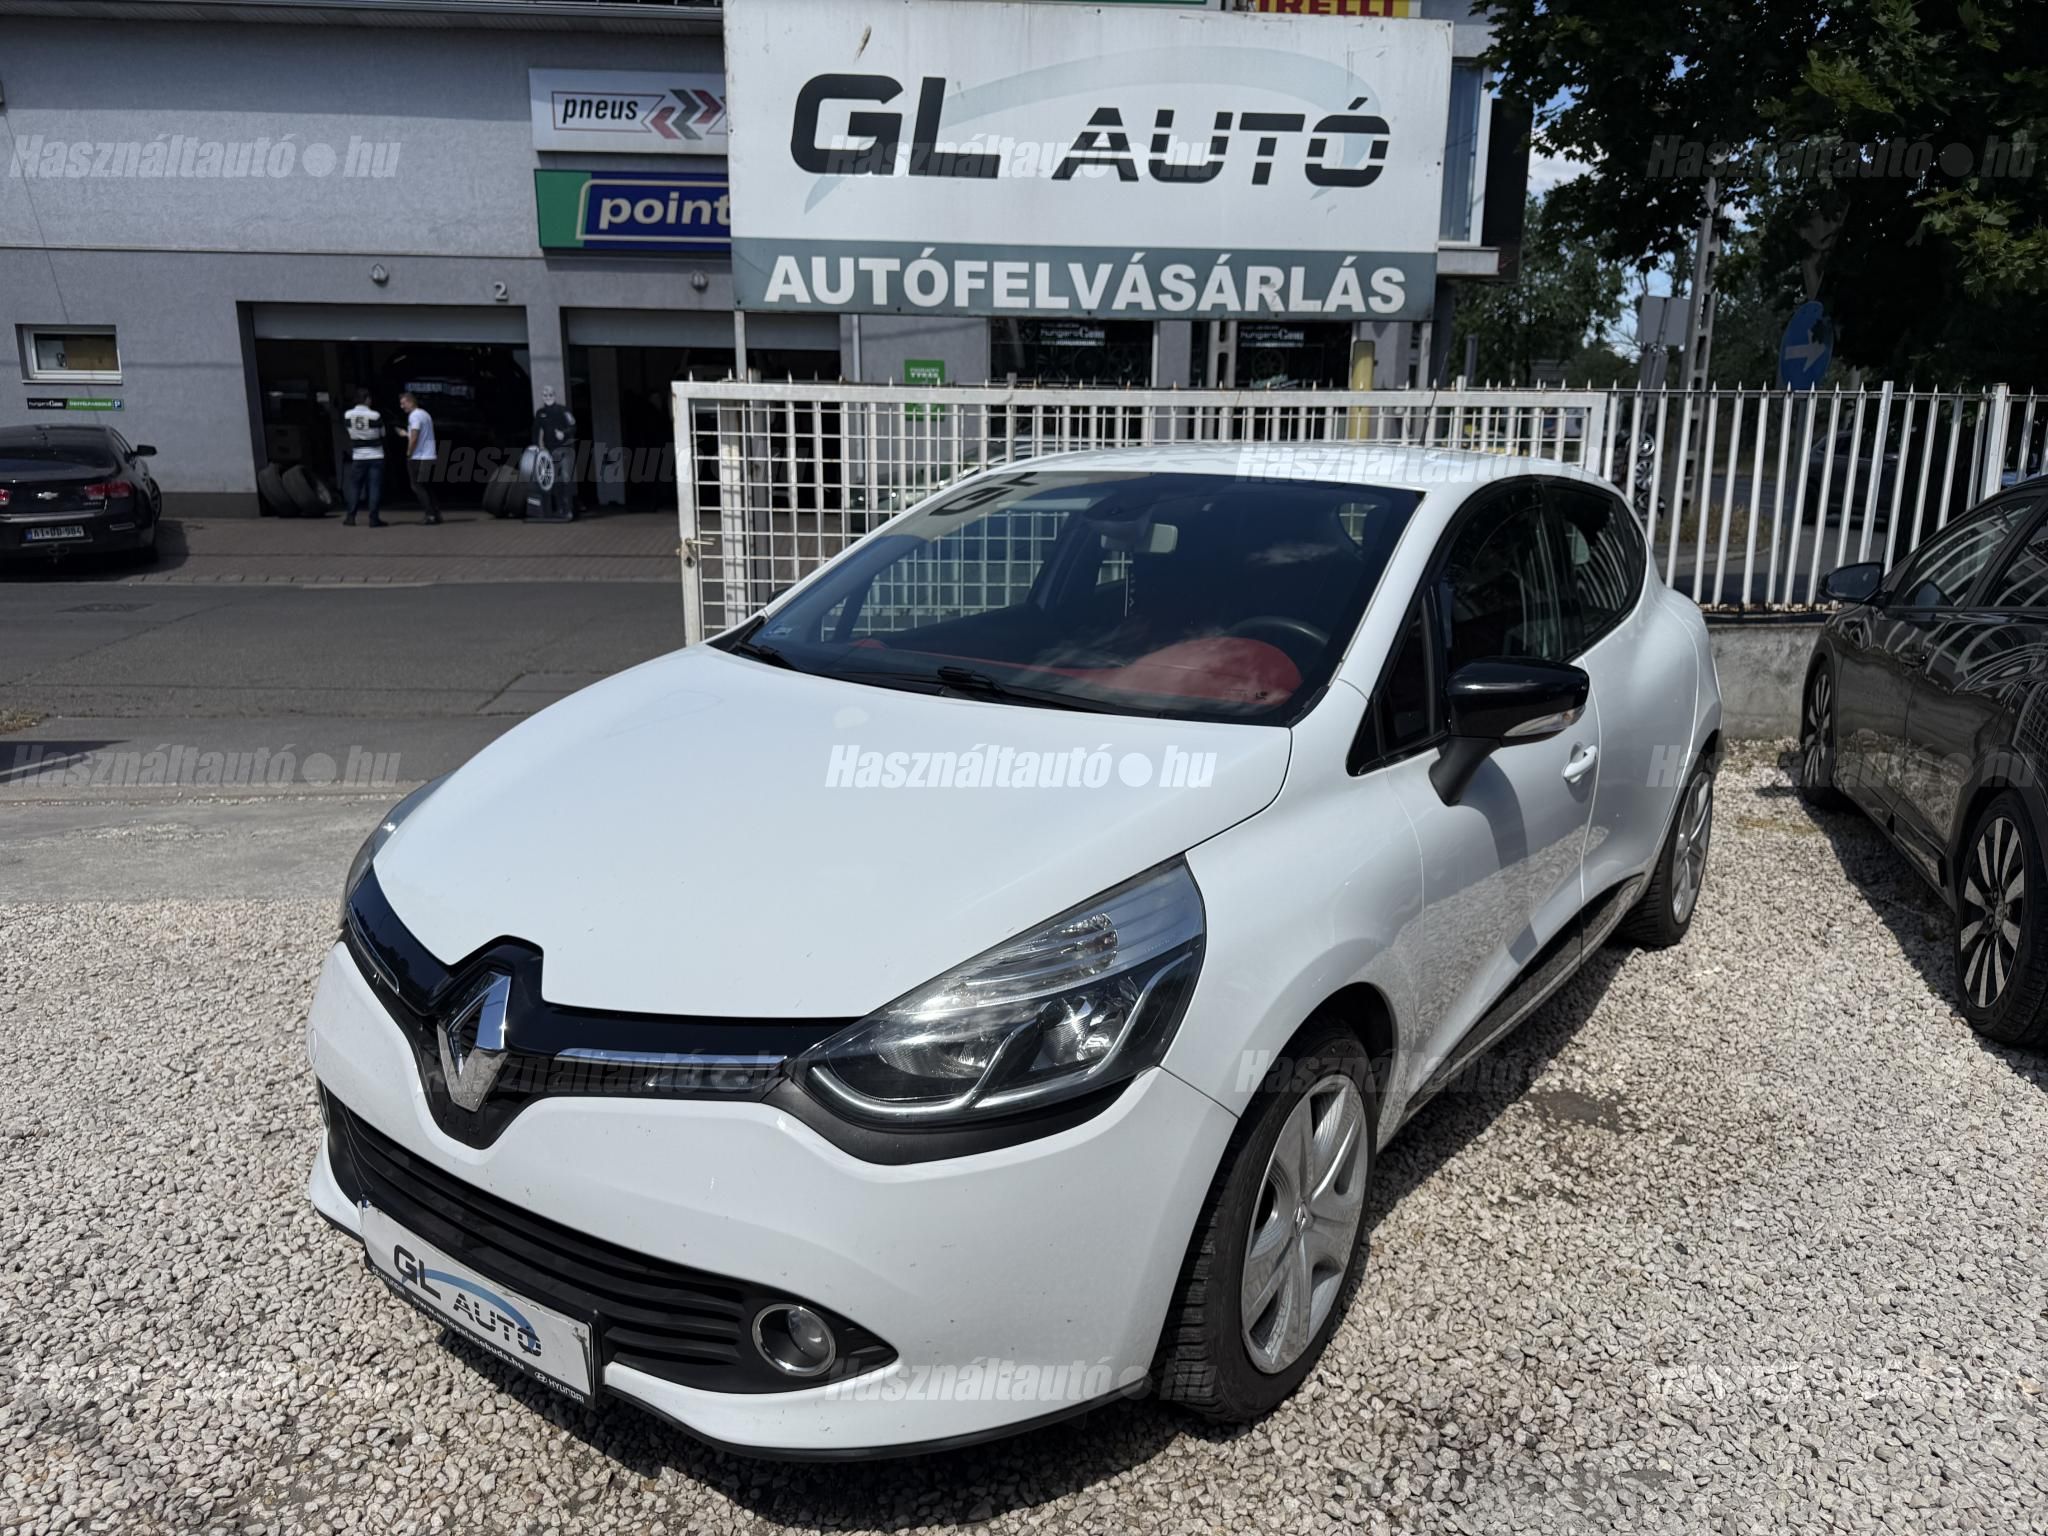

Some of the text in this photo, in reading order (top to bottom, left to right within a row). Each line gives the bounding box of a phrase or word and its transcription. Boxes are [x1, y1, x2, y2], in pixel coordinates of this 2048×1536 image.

[562, 98, 639, 124] pneus
[790, 73, 1391, 188] GL AUTÓ
[598, 191, 731, 230] point
[494, 281, 508, 300] 2
[764, 248, 1406, 315] AUTÓFELVÁSÁRLÁS
[393, 1244, 441, 1300] GL
[411, 1295, 525, 1370] www.autopalacebuda.hu
[549, 1378, 585, 1404] HYUNDAI
